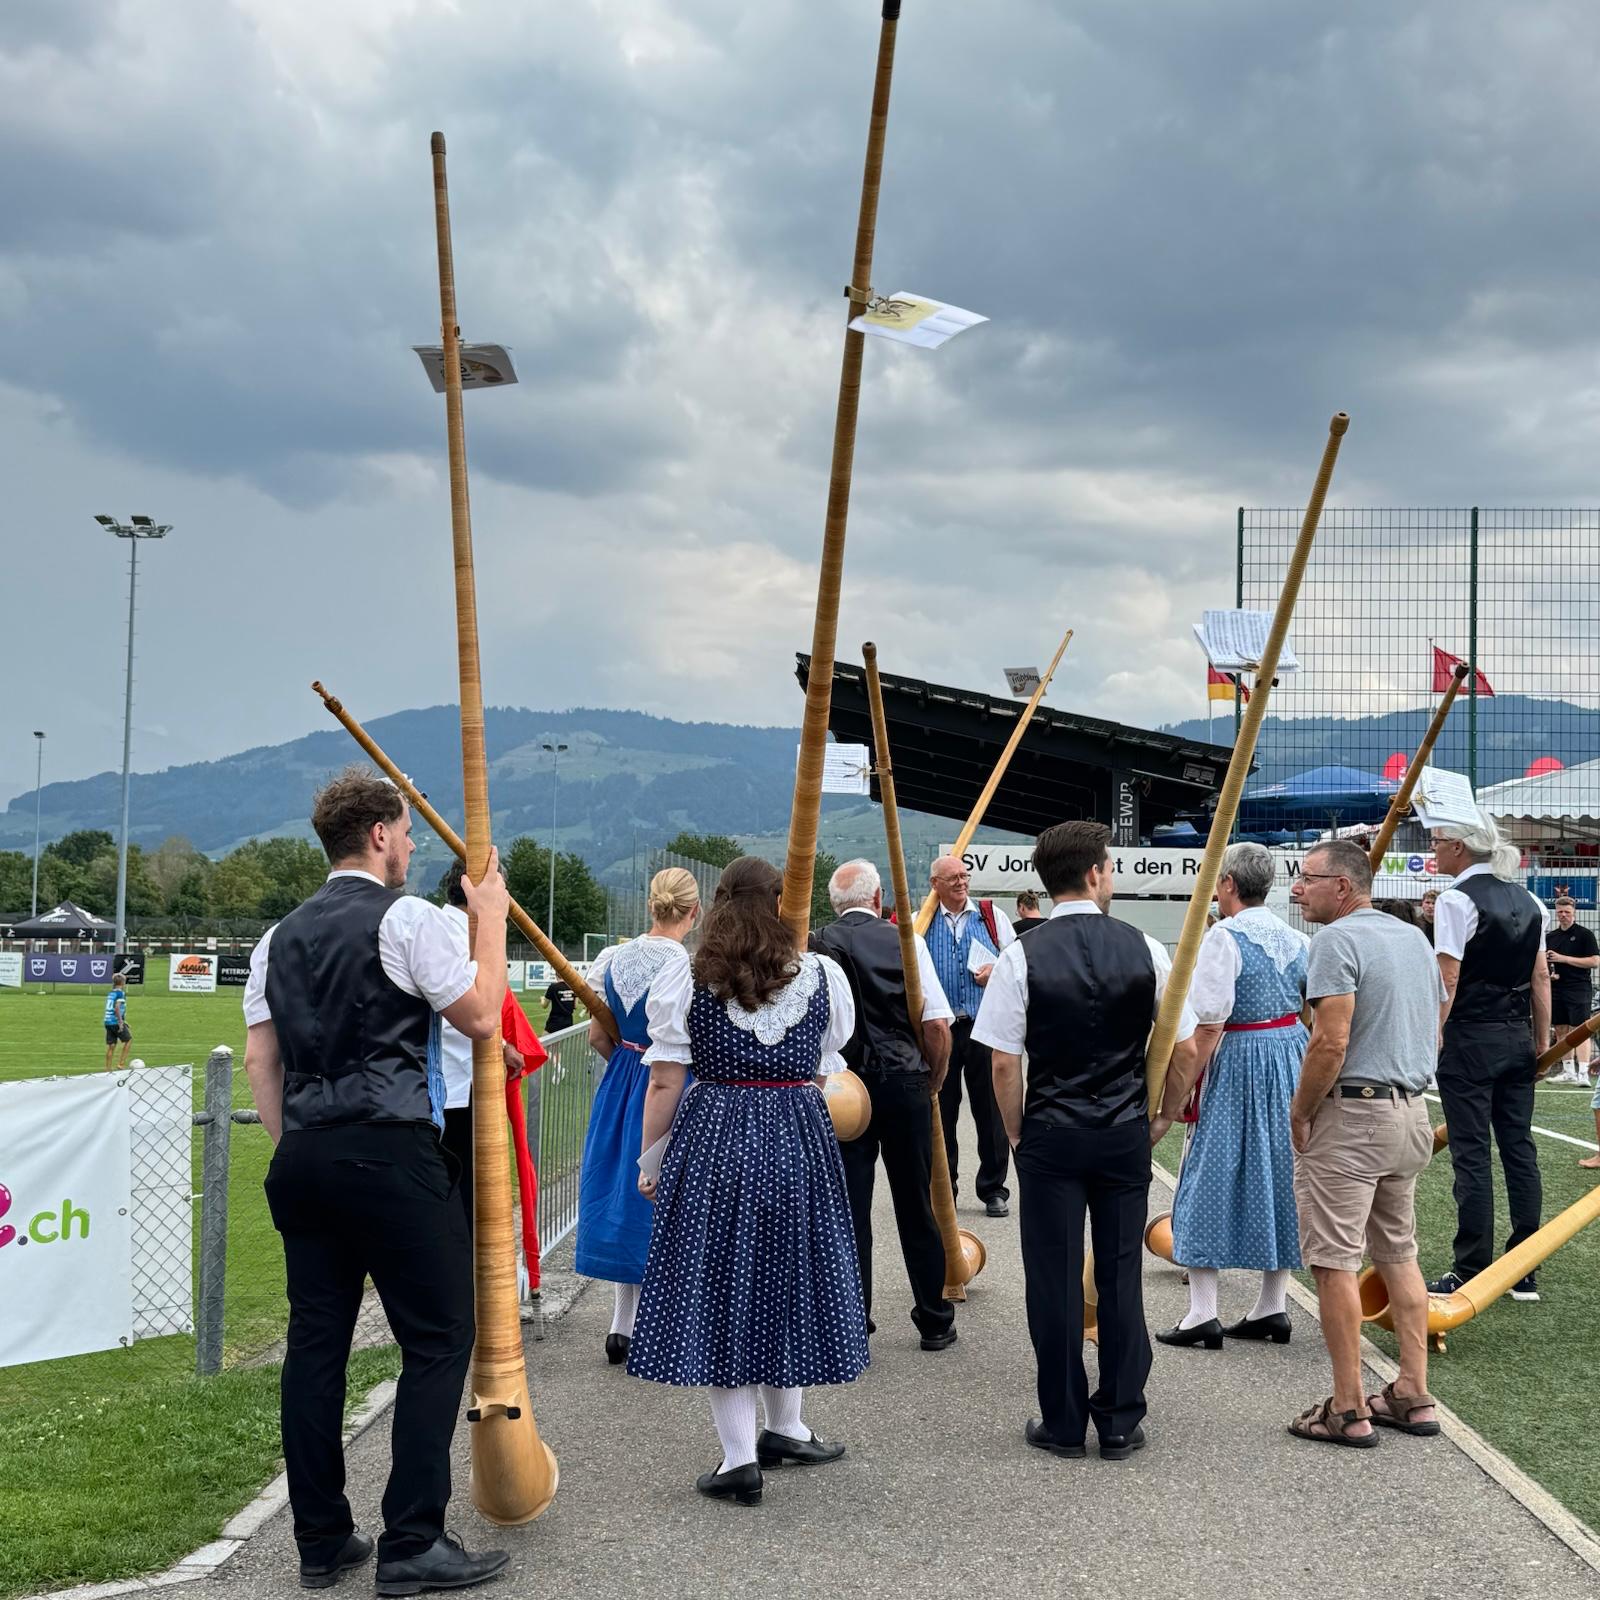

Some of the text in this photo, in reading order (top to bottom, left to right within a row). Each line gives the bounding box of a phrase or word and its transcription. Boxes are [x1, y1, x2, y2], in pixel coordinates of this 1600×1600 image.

[946, 853, 988, 872] SV
[998, 855, 1035, 873] Jon
[1134, 857, 1172, 875] den
[1285, 860, 1301, 877] W
[1378, 855, 1438, 874] wee
